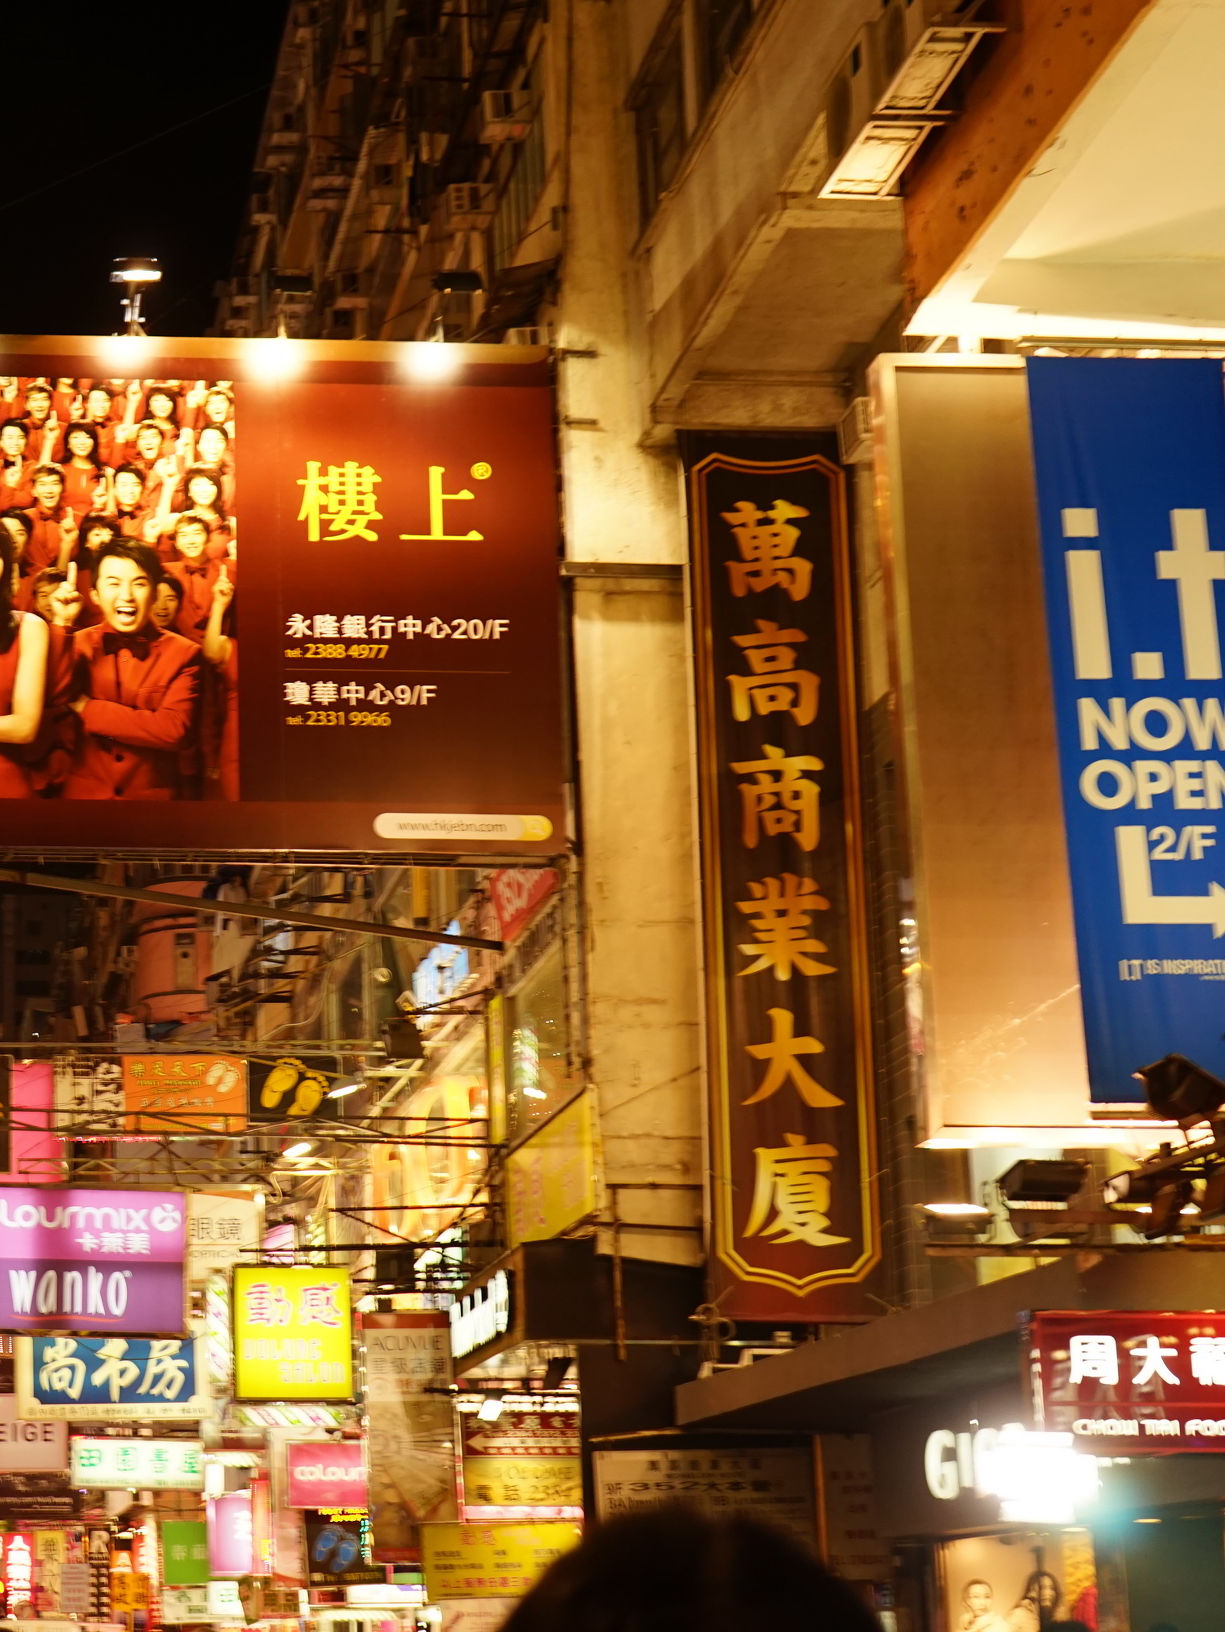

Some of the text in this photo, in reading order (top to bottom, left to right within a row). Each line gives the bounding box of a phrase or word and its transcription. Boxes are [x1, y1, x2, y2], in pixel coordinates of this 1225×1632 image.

[296, 461, 484, 541] 樓上
[1061, 508, 1225, 680] i.t
[284, 613, 510, 640] 永隆銀行中心20/F
[304, 643, 346, 658] 2388
[347, 644, 389, 659] 4977
[305, 710, 345, 726] 2331
[348, 711, 391, 727] 9966
[1077, 696, 1225, 752] NOW
[1148, 825, 1216, 861] 2/F
[719, 498, 853, 1248] 萬高商業大廈
[8, 1266, 128, 1317] wanko
[245, 1282, 342, 1328] 動感
[1072, 1418, 1139, 1436] CHOW
[1185, 1418, 1225, 1436] FOO
